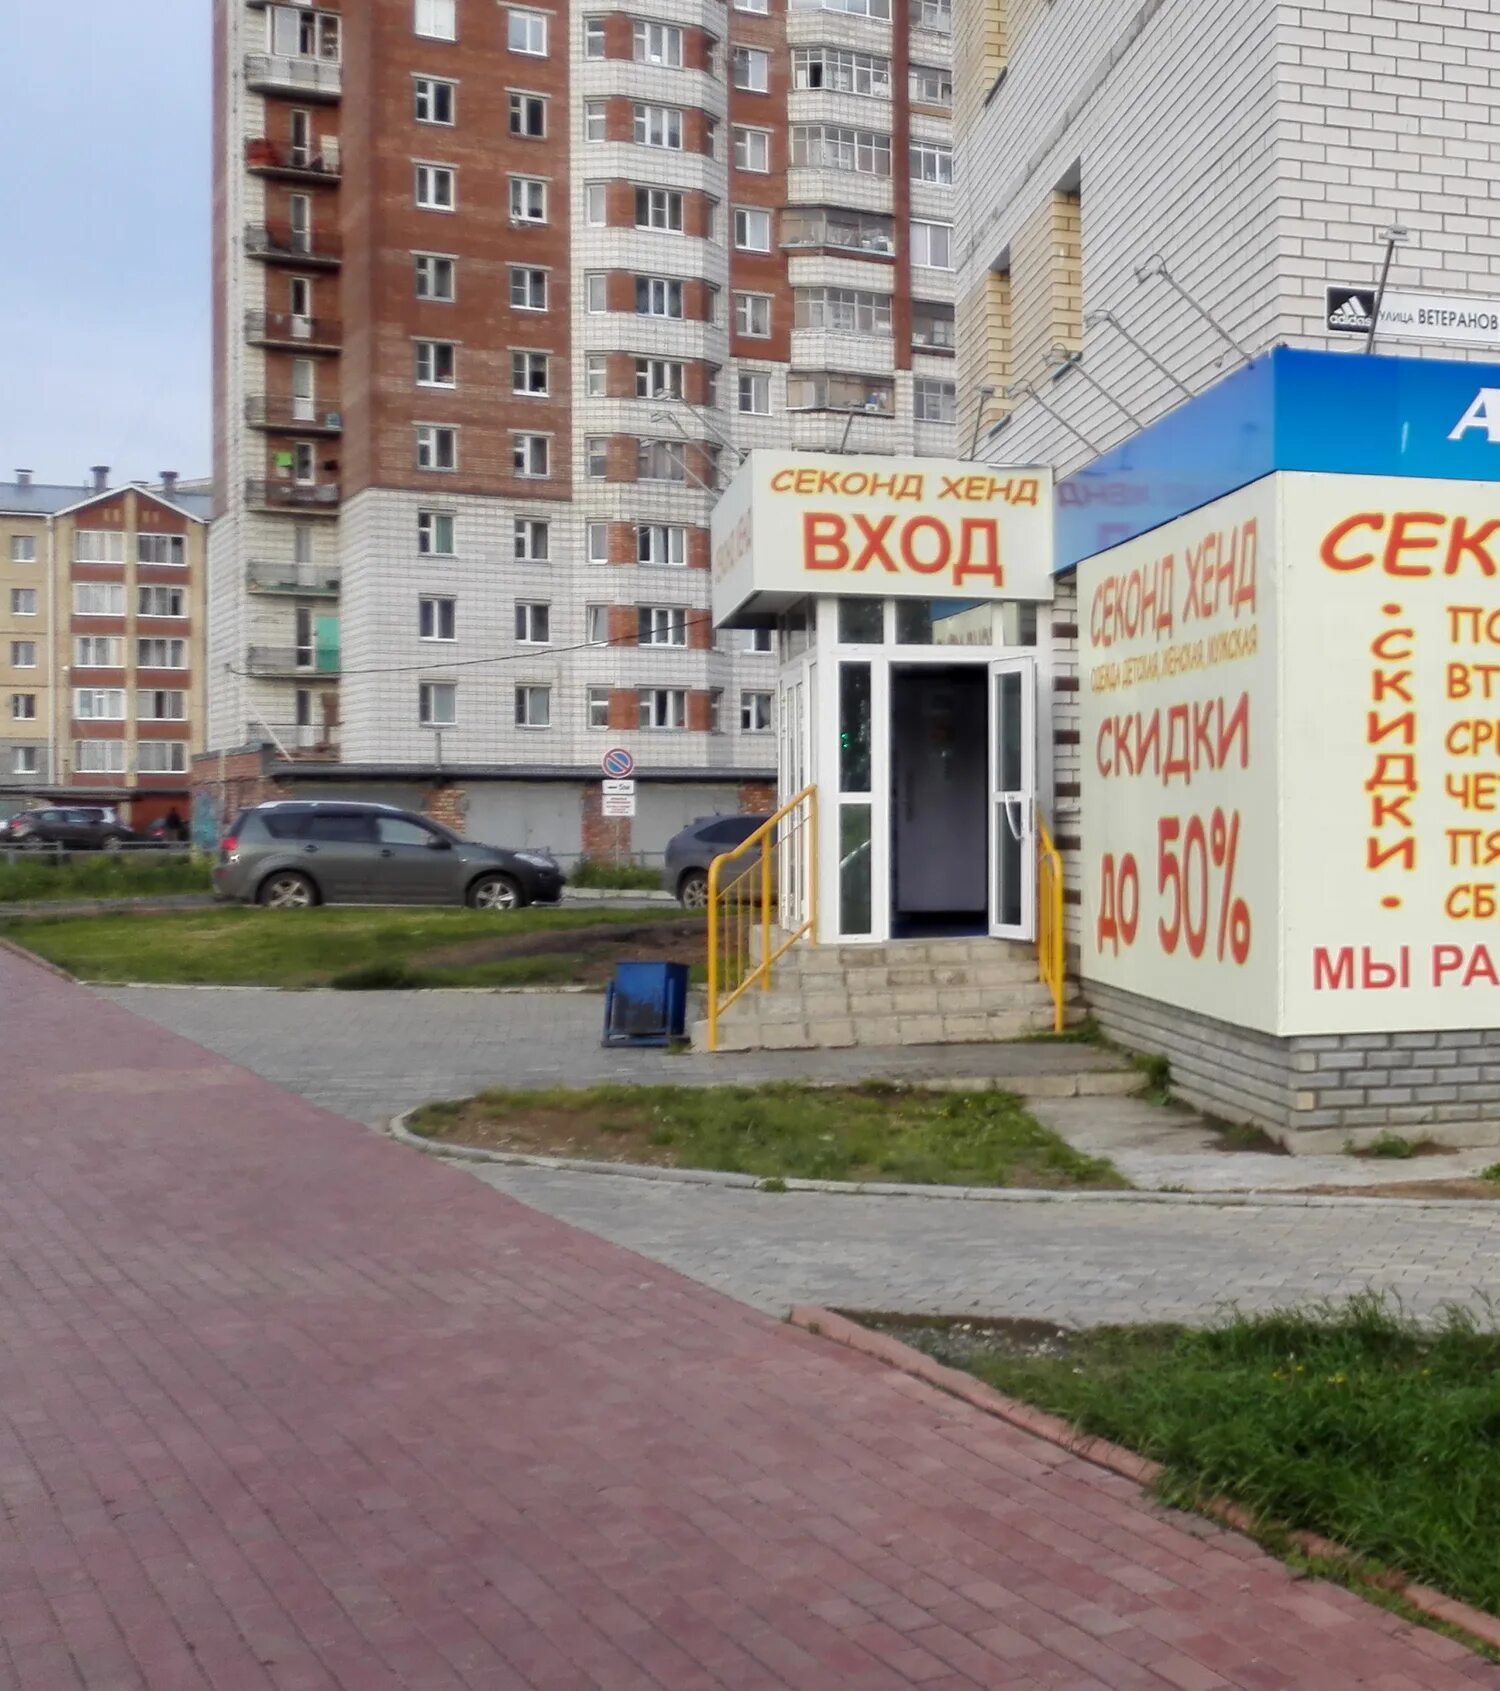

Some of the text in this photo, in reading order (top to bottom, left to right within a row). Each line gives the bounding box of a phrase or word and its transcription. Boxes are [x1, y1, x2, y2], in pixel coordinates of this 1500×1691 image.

[1378, 310, 1415, 324] УЛИЦА
[1418, 308, 1498, 330] ВЕТЕРАНОВ
[770, 468, 924, 502] СЕКОНД
[938, 475, 1040, 506] ХЕНД
[802, 511, 1005, 588] ВХОД
[1090, 516, 1258, 649] СЕКОНД ХЕНД
[1157, 806, 1252, 966] 50%
[1313, 946, 1410, 991] МЫ
